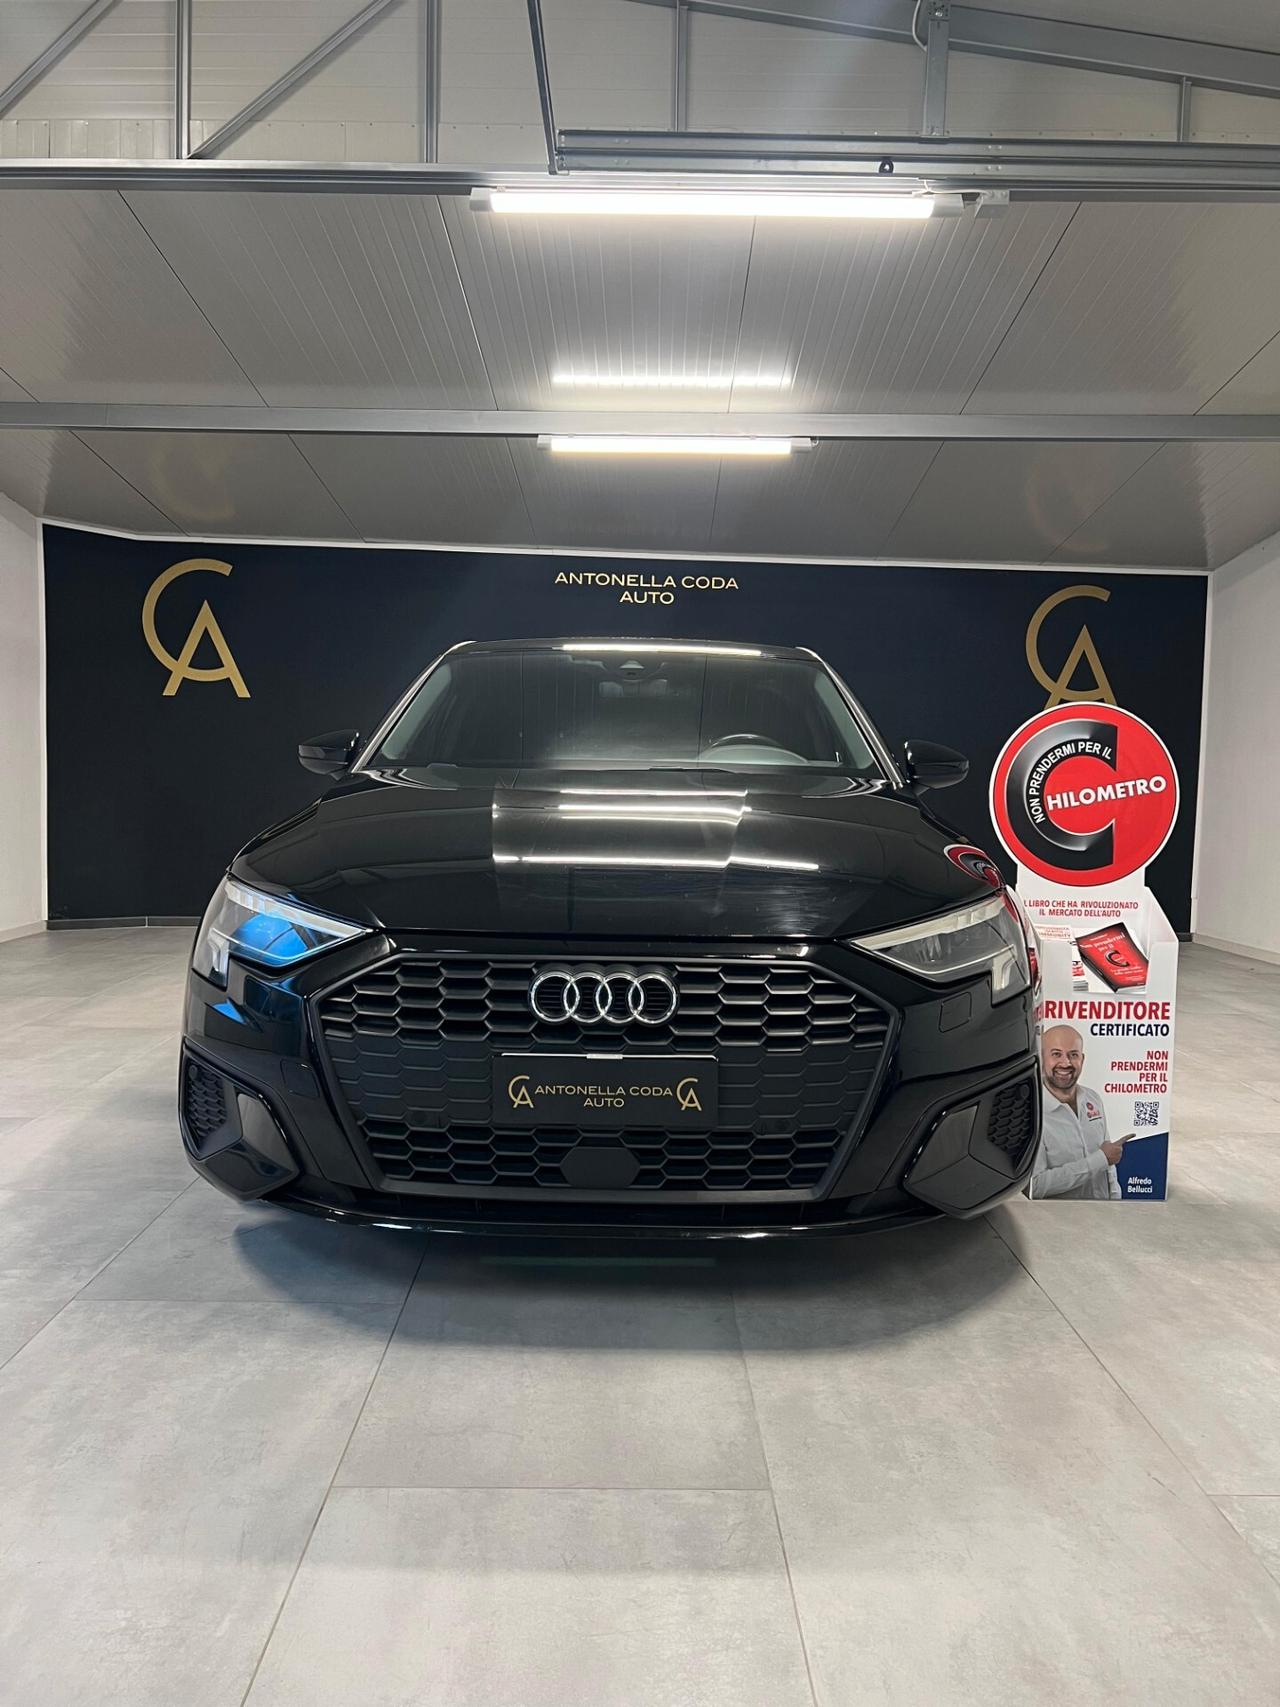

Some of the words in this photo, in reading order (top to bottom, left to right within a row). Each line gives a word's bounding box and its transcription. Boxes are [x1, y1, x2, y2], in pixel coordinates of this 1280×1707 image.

[554, 572, 676, 588] ANTONELLA
[681, 575, 739, 589] CODA
[619, 591, 675, 605] AUTO
[1078, 741, 1102, 754] PER
[1102, 746, 1112, 760] IL
[1028, 742, 1076, 796] PRENDERMI
[1029, 798, 1046, 824] NON
[1029, 900, 1050, 908] LIBRO
[1051, 900, 1066, 908] CHE
[1067, 900, 1078, 908] HA
[1080, 902, 1139, 910] RIVOLUZIONATO
[1048, 909, 1082, 917] MERCATO
[1083, 910, 1121, 918] DELL'AUTO
[1044, 1000, 1171, 1021] RIVENDITORE
[1090, 1023, 1170, 1037] CERTIFICATO
[1146, 1050, 1169, 1060] NON
[1110, 1061, 1168, 1071] PRENDERMI
[1138, 1072, 1157, 1082] PER
[1159, 1073, 1168, 1082] IL
[535, 1085, 626, 1096] ANTONELLA
[629, 1086, 673, 1097] CODA
[1104, 1083, 1167, 1093] CHILOMETRO
[583, 1098, 625, 1108] AUTO
[1127, 1176, 1152, 1185] Alfredo
[1127, 1185, 1153, 1193] Bellucci
